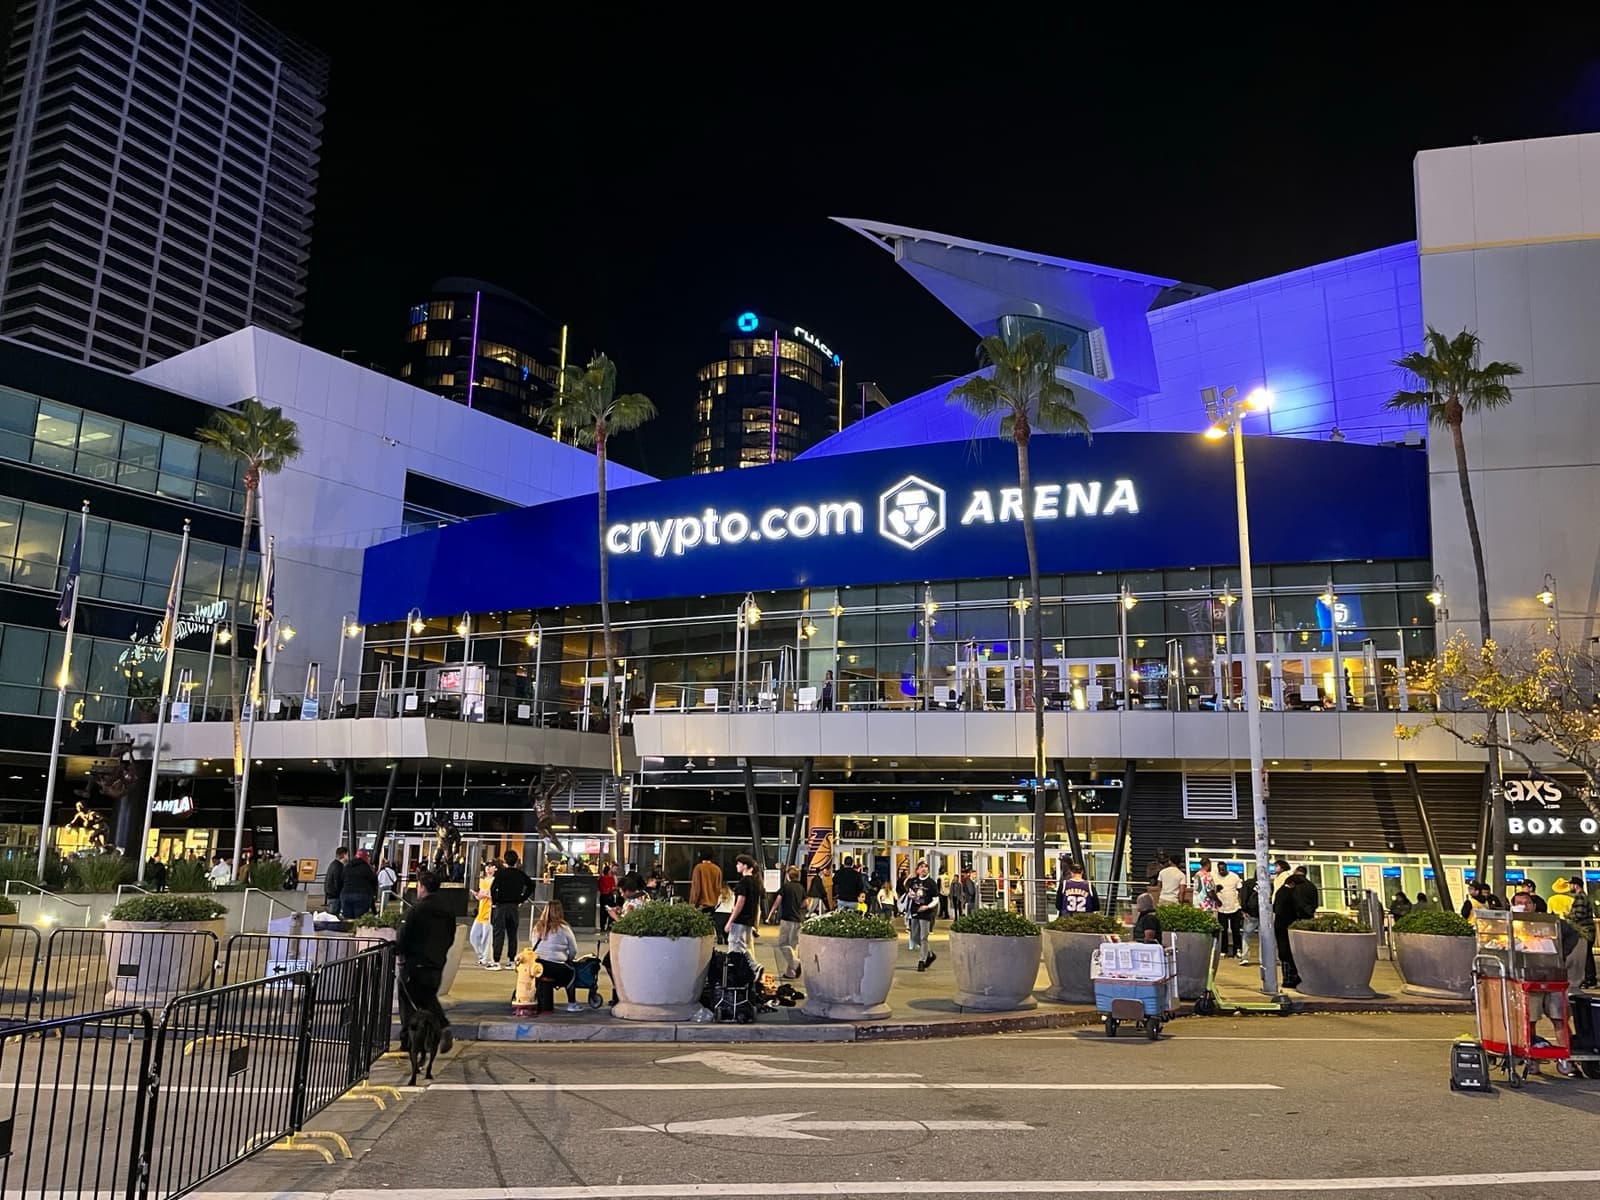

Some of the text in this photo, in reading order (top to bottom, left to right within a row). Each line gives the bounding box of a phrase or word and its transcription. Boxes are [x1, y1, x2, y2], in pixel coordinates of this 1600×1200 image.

[606, 479, 1140, 557] crypto.com ARENA
[1504, 780, 1562, 805] axs
[453, 811, 473, 820] BAR
[1508, 817, 1565, 834] BOX
[1067, 896, 1086, 912] 32
